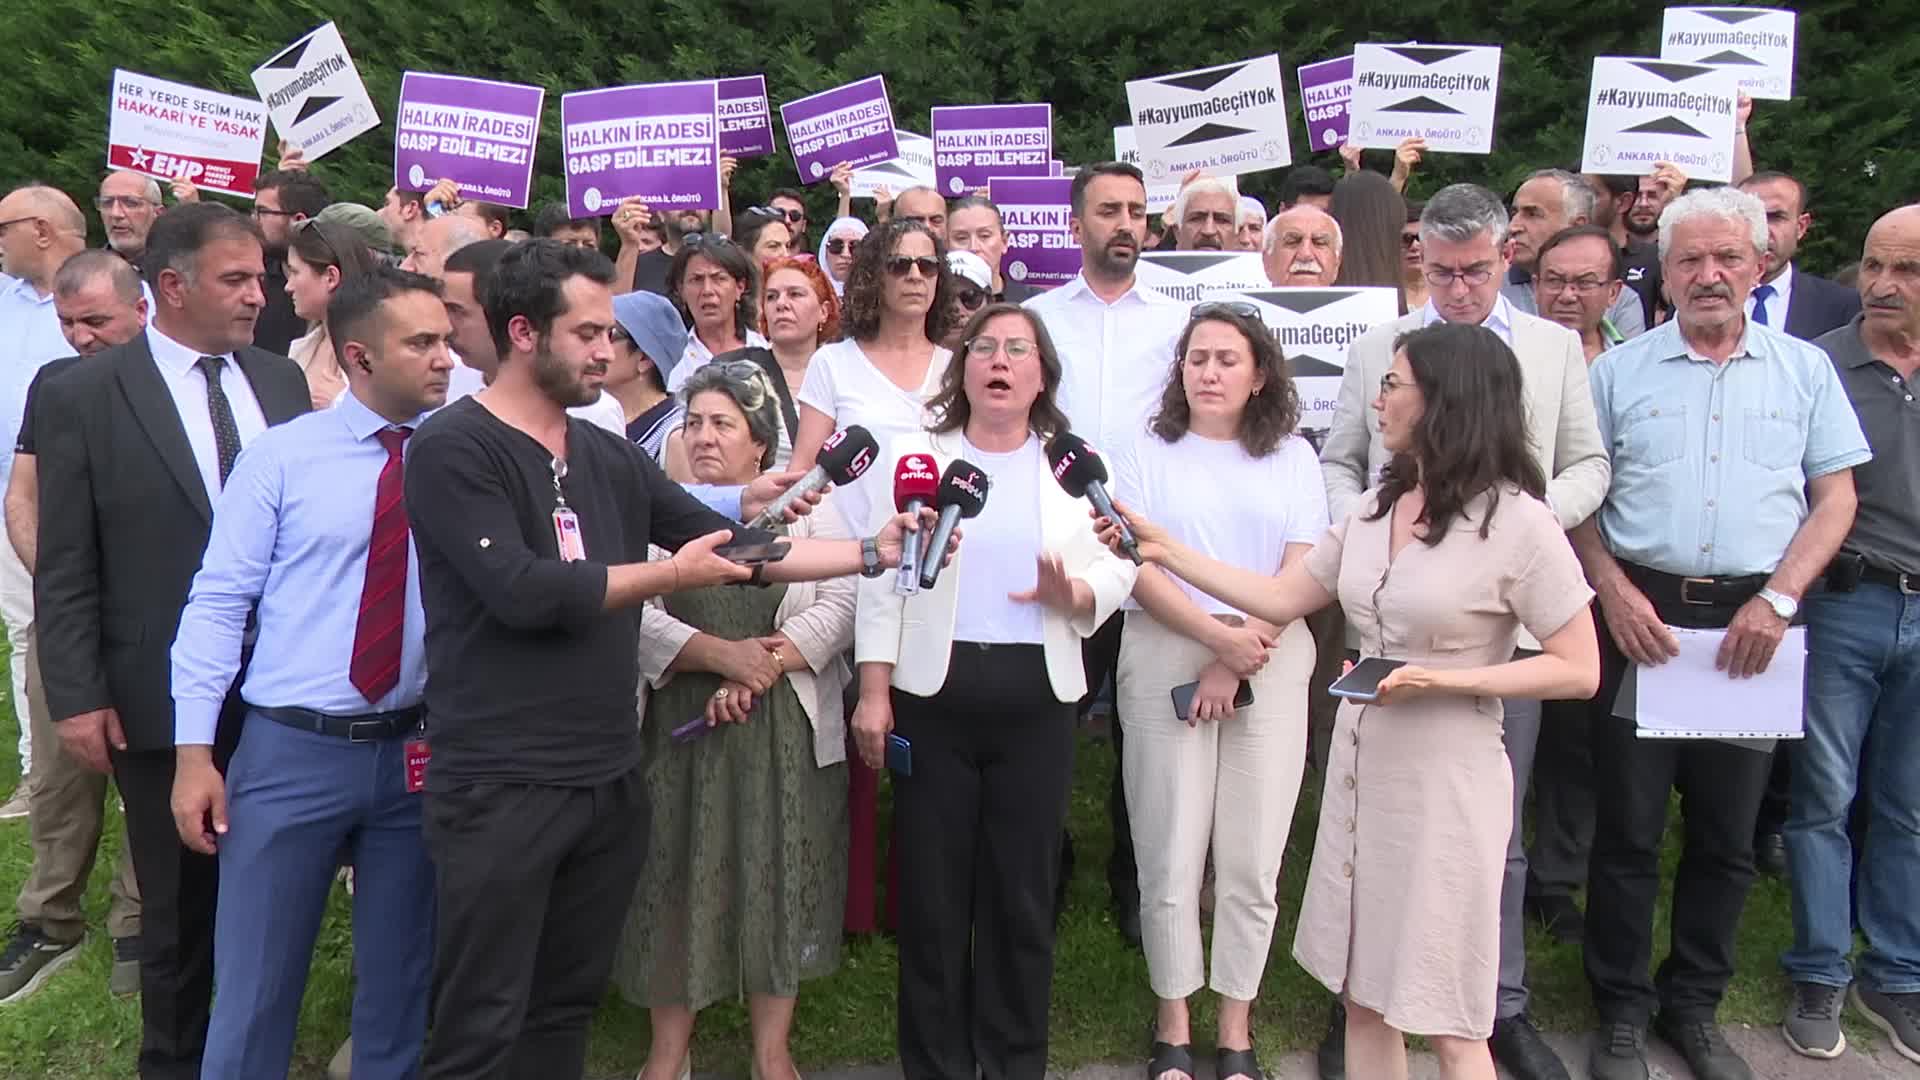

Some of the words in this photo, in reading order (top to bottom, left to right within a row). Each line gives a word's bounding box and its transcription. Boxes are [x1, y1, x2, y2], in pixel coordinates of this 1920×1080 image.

[1667, 30, 1789, 51] #KayyumaGeçitYok
[267, 53, 348, 111] #KayyumaGeçitYok
[1358, 71, 1491, 96] #KayyumaGeçitYok
[119, 81, 143, 97] HER
[150, 89, 189, 109] YERDE
[234, 108, 261, 125] HAK
[719, 97, 764, 116] RADESİ
[1138, 86, 1276, 126] #KayyumaGeçitYok
[1308, 104, 1344, 122] GASP
[1596, 88, 1732, 117] #KayyumaGeçitYok
[213, 119, 260, 140] YASAK
[403, 109, 460, 129] HALKIN
[462, 111, 532, 140] İRADESİ
[569, 125, 631, 148] HALKIN
[635, 117, 711, 141] İRADESİ
[719, 116, 767, 132] LEMEZ!
[791, 116, 834, 140] HALKIN
[836, 100, 886, 127] İRADESİ
[794, 137, 826, 157] GASP
[826, 119, 890, 148] EDİLEMEZ!
[937, 134, 987, 148] HALKIN
[989, 130, 1046, 147] İRADESİ
[1375, 128, 1413, 138] ANKARA
[1424, 127, 1462, 140] ÖRGÜTÜ
[399, 132, 438, 151] GASP
[439, 134, 528, 165] EDİLEMEZ!
[568, 152, 612, 175] GASP
[614, 145, 712, 170] EDİLEMEZ!
[936, 152, 973, 167] GASP
[973, 149, 1046, 167] EDİLEMEZ!
[1169, 160, 1209, 173] ANKARA
[1209, 154, 1220, 167] İL
[1220, 148, 1258, 165] ÖRGÜTÜ
[1616, 151, 1661, 161] ANKARA
[1673, 151, 1707, 166] ÖRGÜTÜ
[151, 153, 204, 178] EHP
[1008, 232, 1039, 249] ASP
[1313, 393, 1337, 412] ÖRG
